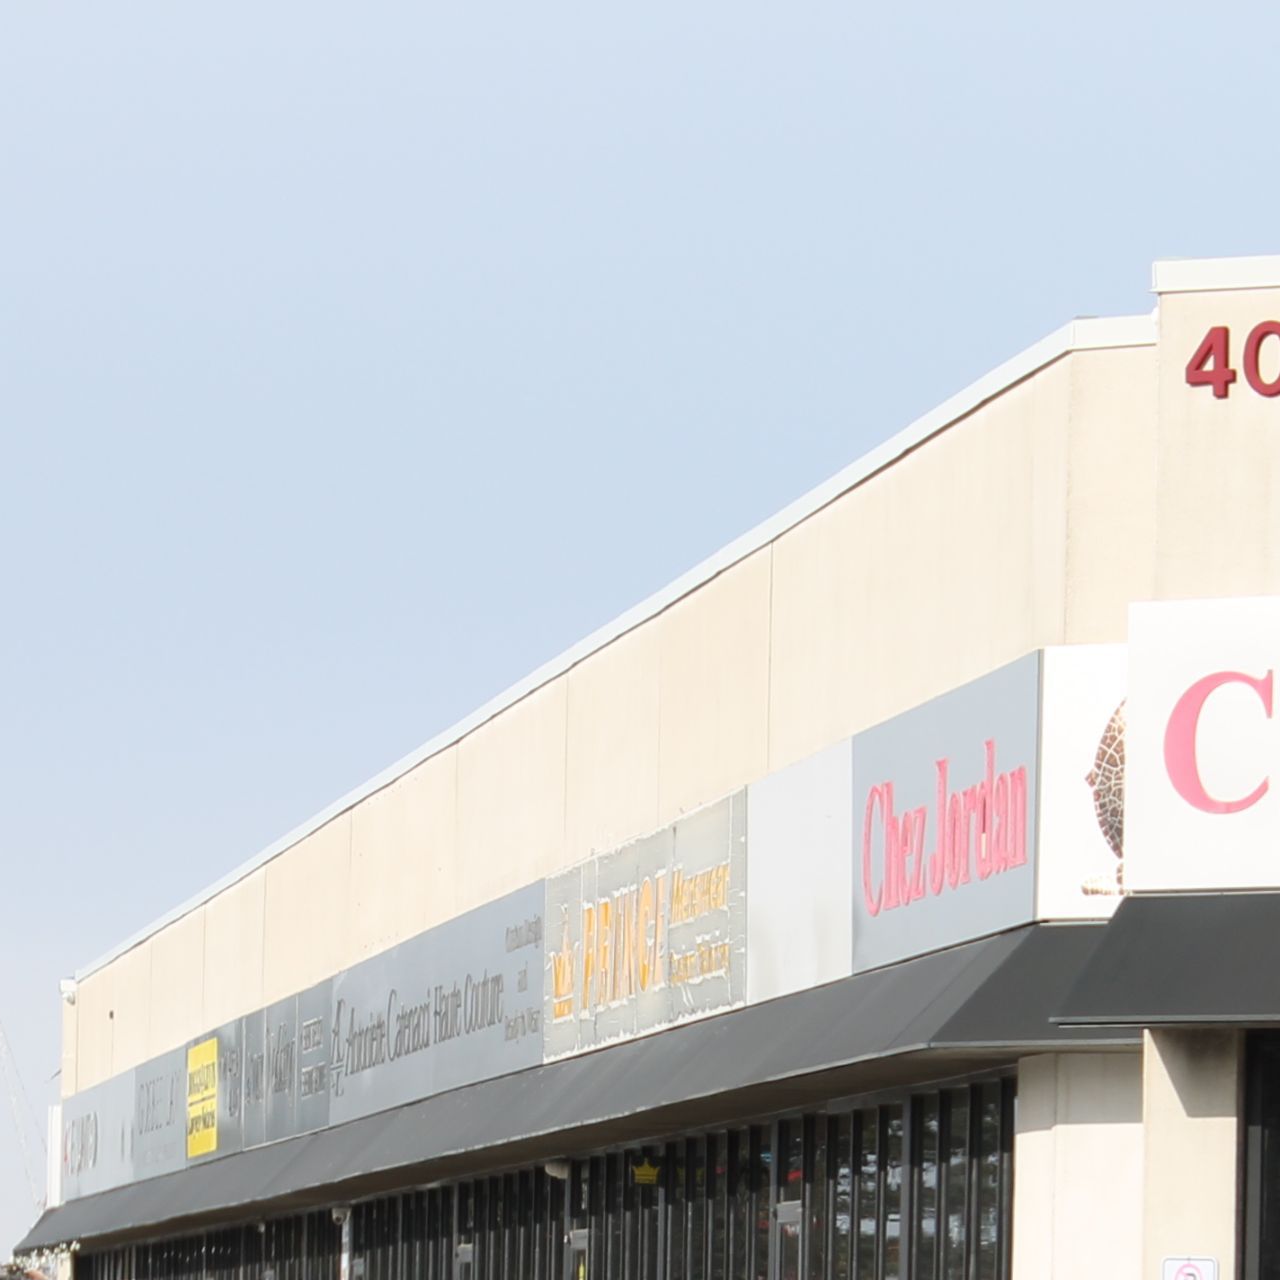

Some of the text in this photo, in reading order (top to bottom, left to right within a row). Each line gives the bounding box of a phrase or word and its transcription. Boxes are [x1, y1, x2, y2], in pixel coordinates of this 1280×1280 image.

[863, 738, 1027, 916] Chez Jordan
[433, 981, 462, 1044] Haute
[463, 969, 503, 1035] Couture
